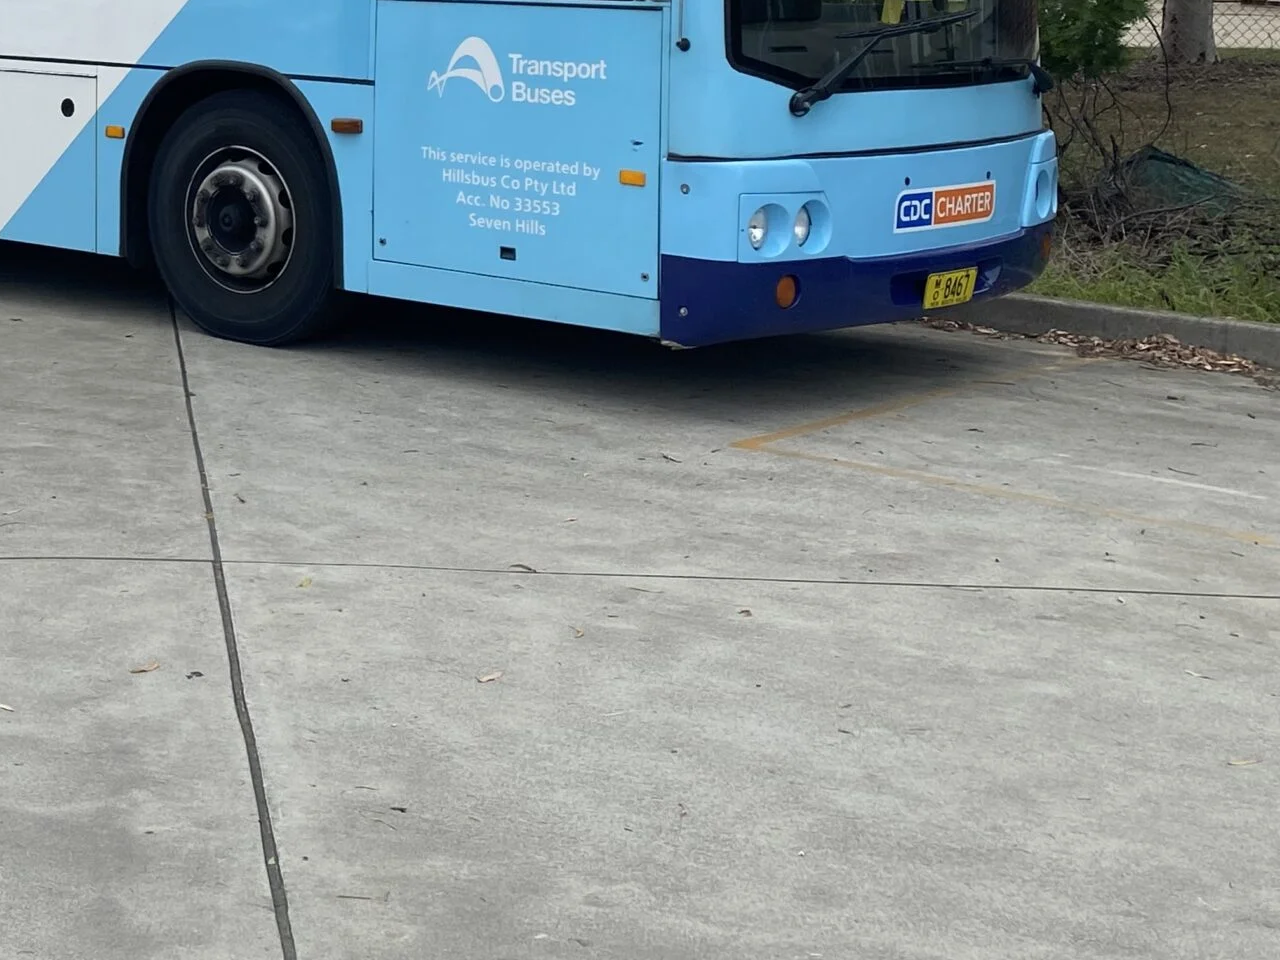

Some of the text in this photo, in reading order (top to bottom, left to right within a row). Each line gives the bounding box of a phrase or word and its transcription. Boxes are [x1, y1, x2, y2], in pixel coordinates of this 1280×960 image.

[508, 52, 608, 82] Transport
[511, 82, 576, 106] Buses
[421, 146, 601, 180] This service is operated by
[442, 168, 576, 196] Hillsbus Co Pty Ltd
[456, 191, 561, 216] Acc. No 33553
[900, 191, 992, 222] CDC CHARTER
[469, 213, 546, 236] Seven Hills
[944, 274, 970, 298] 8467
